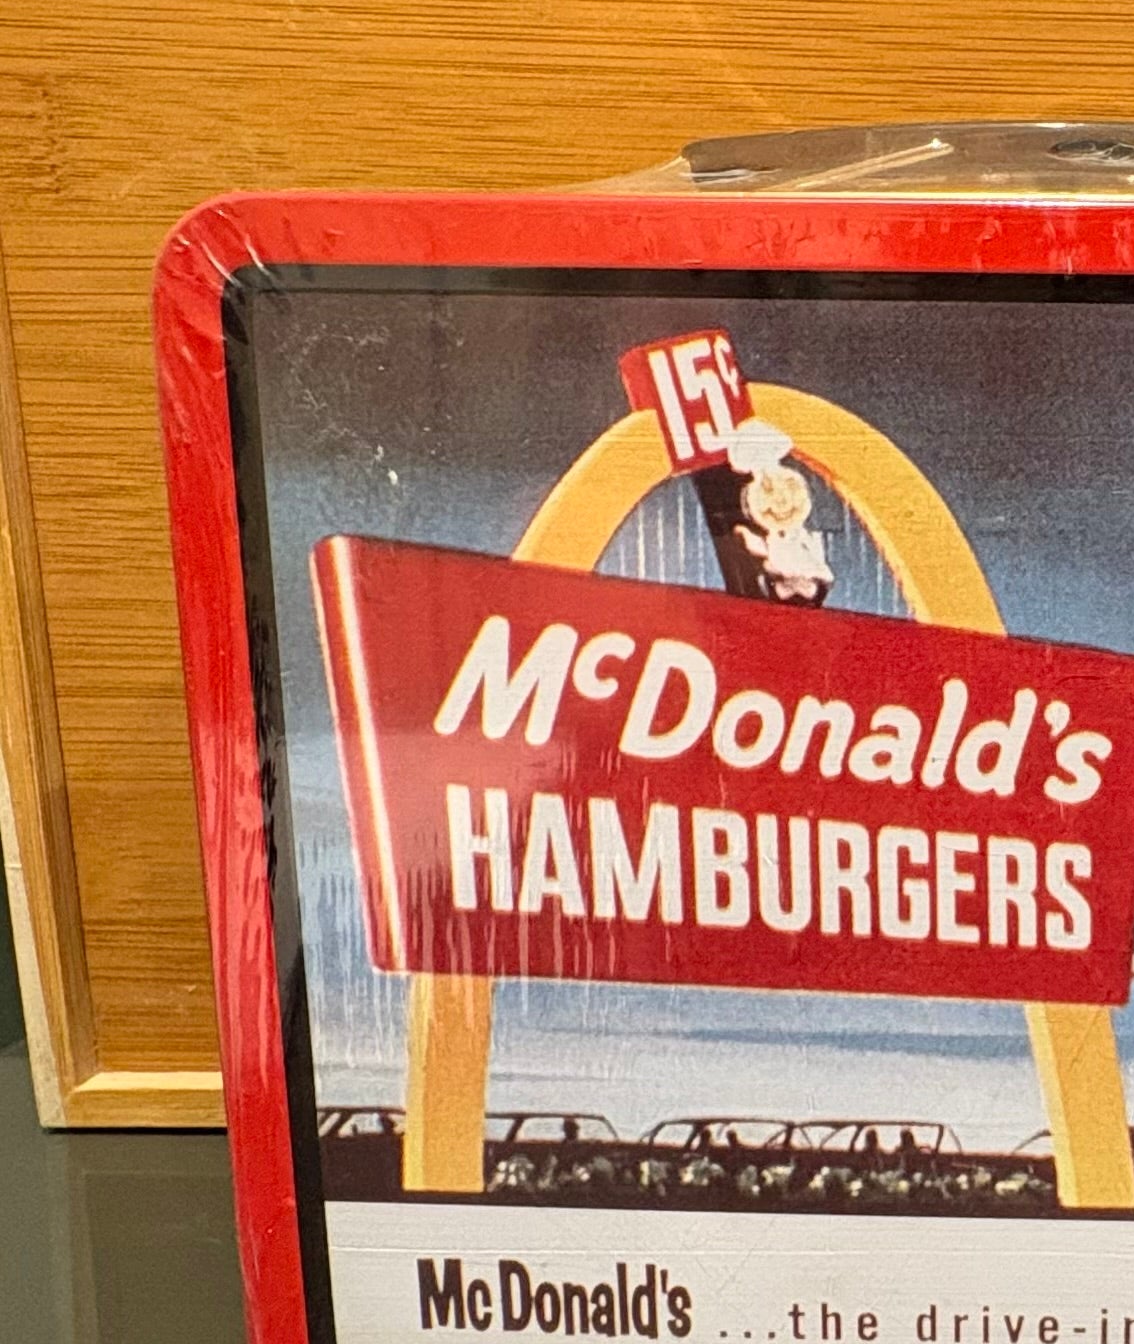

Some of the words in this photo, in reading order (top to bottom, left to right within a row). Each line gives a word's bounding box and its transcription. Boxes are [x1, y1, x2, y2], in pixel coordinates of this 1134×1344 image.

[432, 614, 1113, 806] McDonald's
[446, 783, 1092, 952] HAMBURGERS
[417, 1258, 692, 1338] McDonald's
